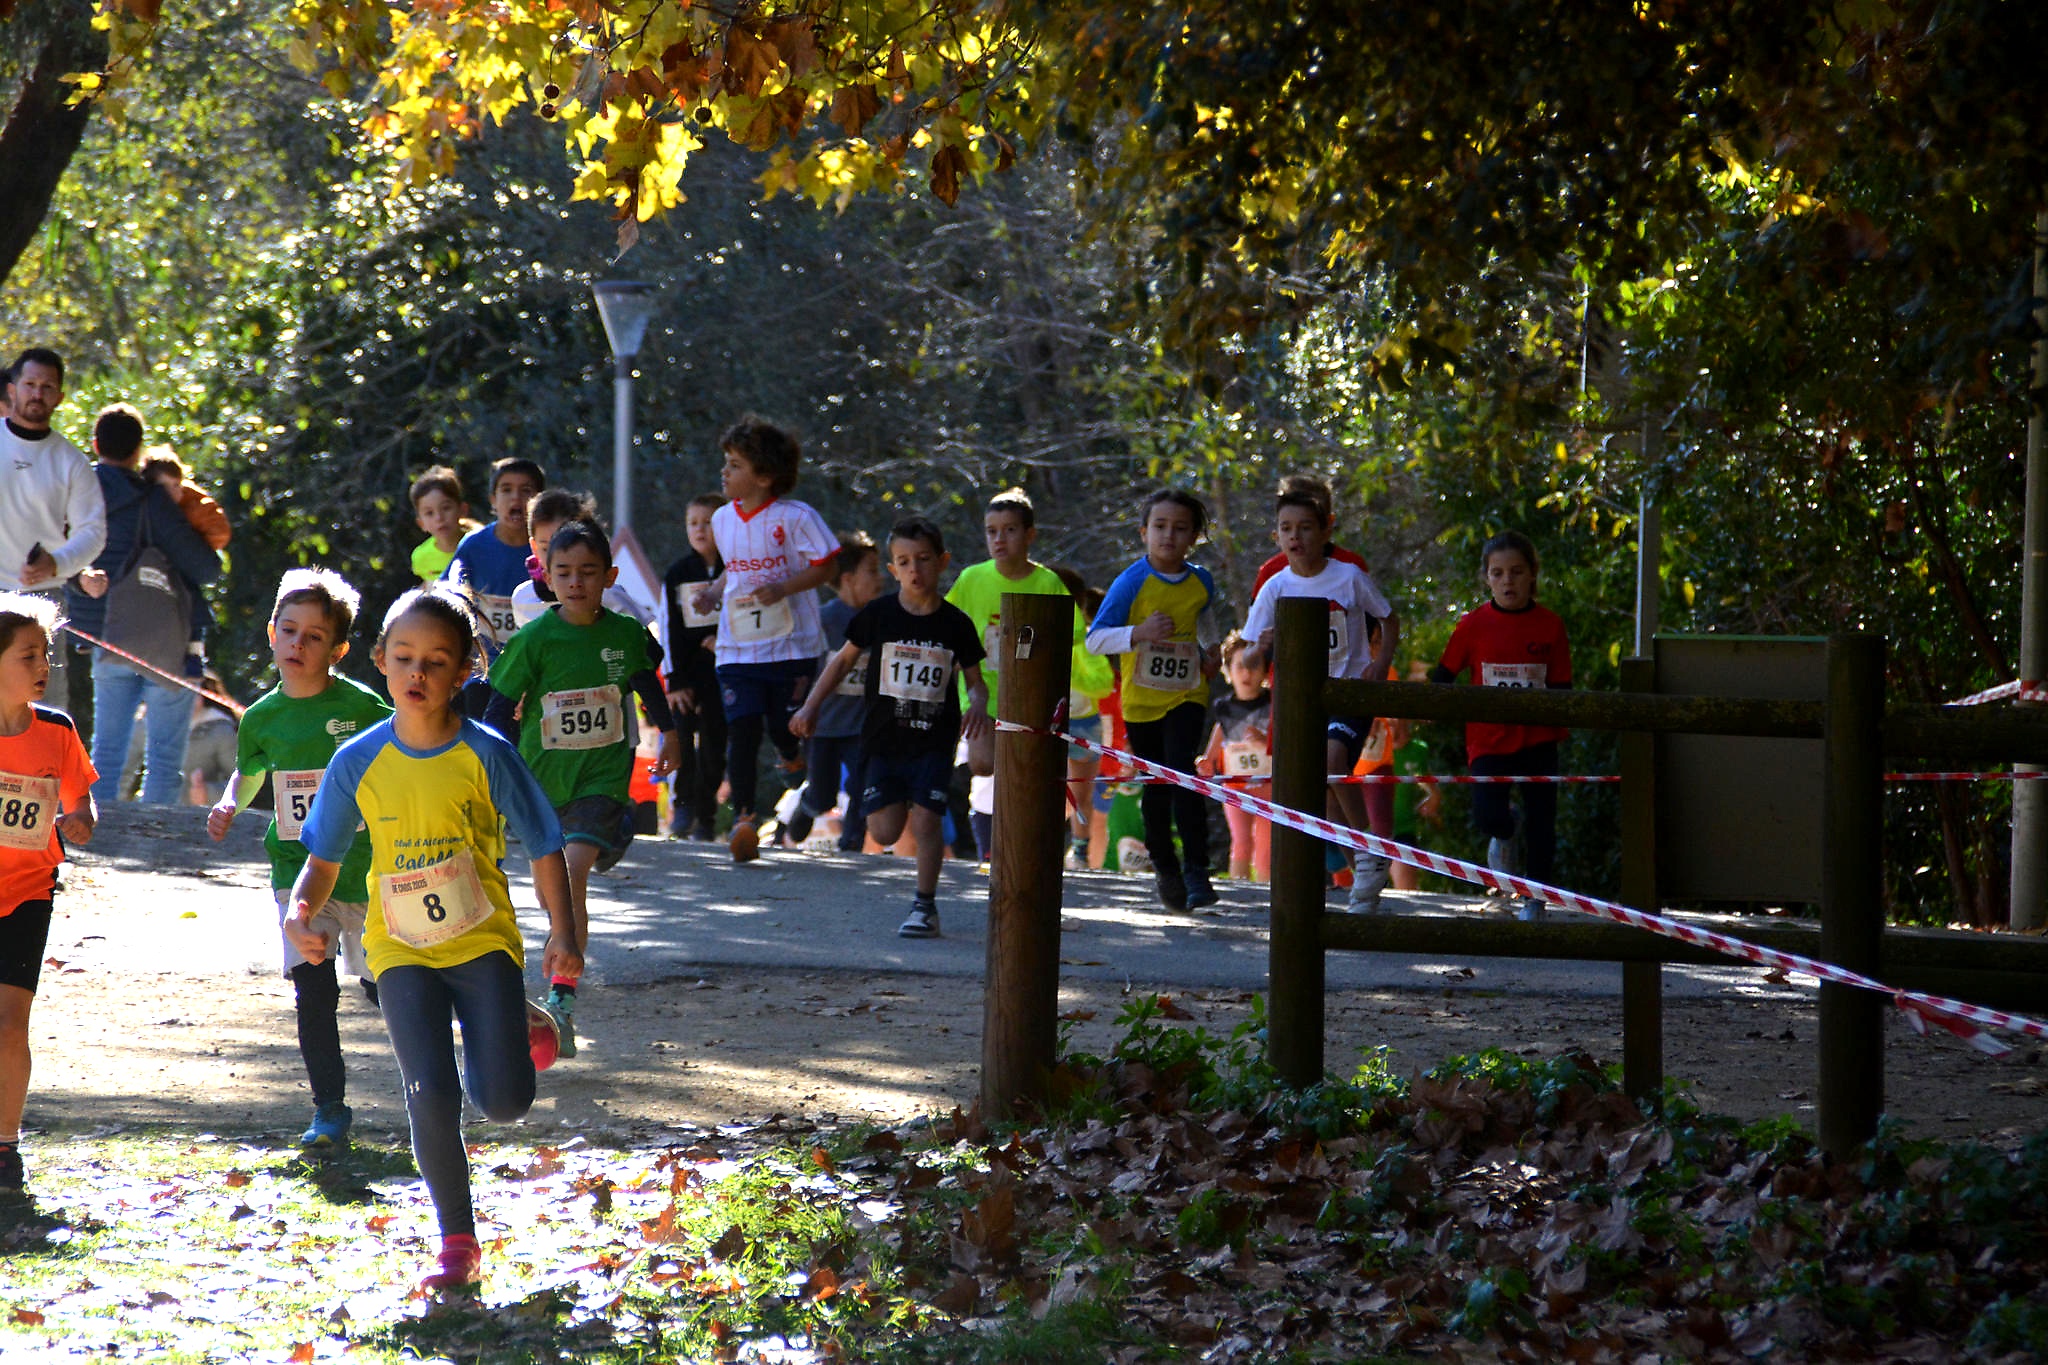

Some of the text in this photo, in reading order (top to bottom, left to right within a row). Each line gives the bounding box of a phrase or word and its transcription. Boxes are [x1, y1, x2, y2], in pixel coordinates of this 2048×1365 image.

[492, 612, 520, 631] 58
[750, 610, 761, 628] 7
[890, 662, 943, 688] 1149
[1150, 656, 1189, 679] 895
[561, 707, 608, 735] 594
[0, 797, 40, 830] 88
[423, 893, 446, 923] 8
